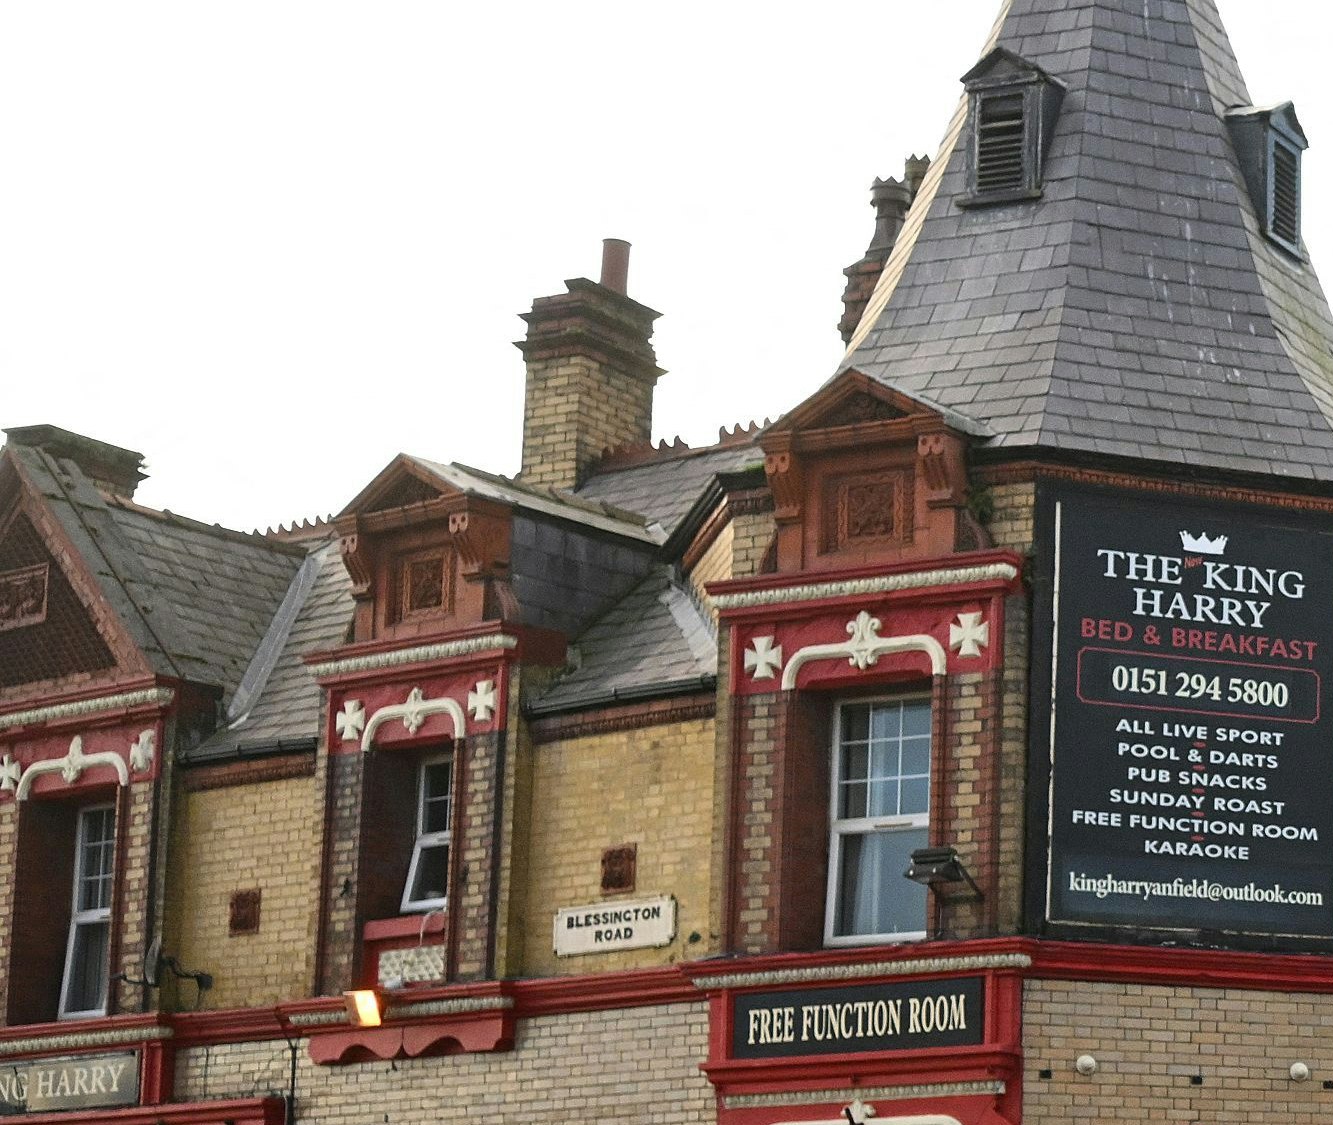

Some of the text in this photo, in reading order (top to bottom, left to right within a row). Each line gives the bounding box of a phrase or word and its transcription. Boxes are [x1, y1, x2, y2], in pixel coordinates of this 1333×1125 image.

[1097, 549, 1306, 599] THE KING
[1132, 587, 1271, 628] HARRY
[1081, 618, 1318, 660] BED & BREAKFAST
[1112, 665, 1289, 708] 0151 294 5800
[1115, 718, 1285, 746] ALL LIVE SPORT
[1117, 742, 1278, 769] POOL & DARTS
[1127, 767, 1267, 791] PUB SNACKS
[1109, 788, 1285, 815] SUNDAY ROAST
[1072, 810, 1318, 841] FREE FUNCTION ROOM
[1144, 840, 1249, 860] KARAOKE
[1069, 871, 1323, 906] kingharryanfield@outlook.com
[566, 906, 661, 929] BLESSINGTON
[594, 927, 633, 943] ROAD
[748, 994, 967, 1045] FREE FUNCTION ROOM
[36, 1062, 126, 1099] HARRY
